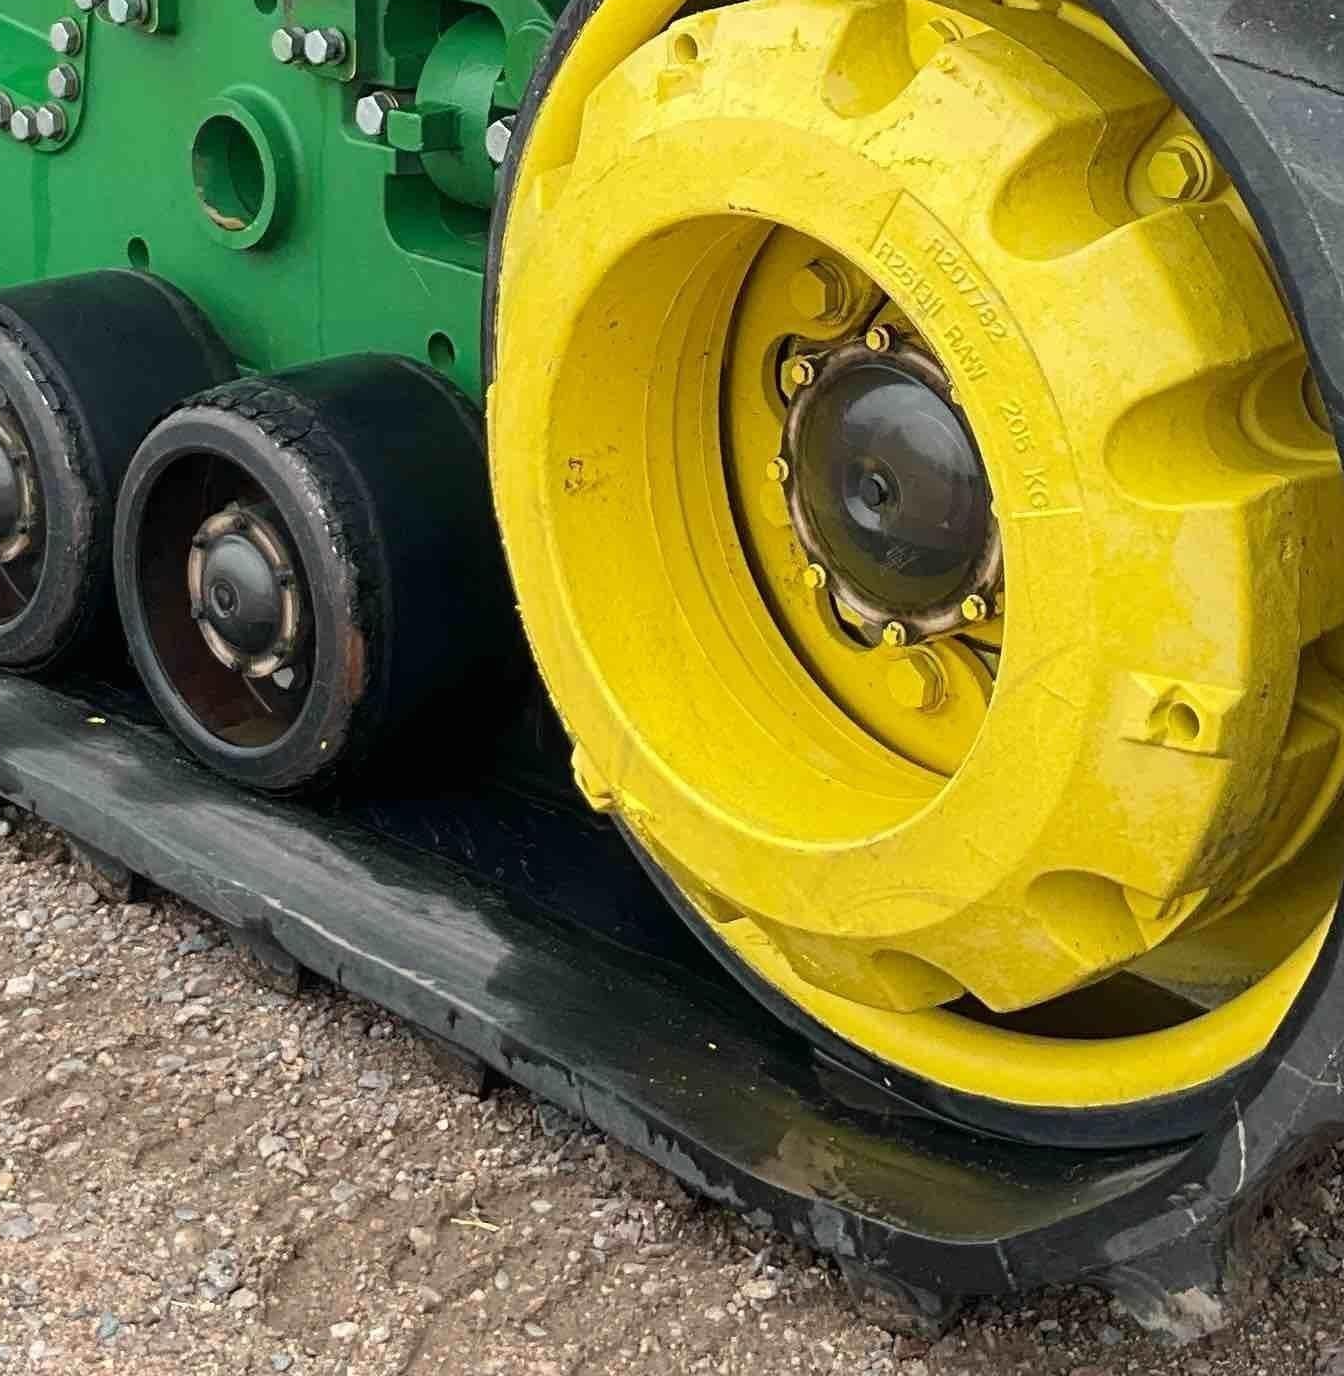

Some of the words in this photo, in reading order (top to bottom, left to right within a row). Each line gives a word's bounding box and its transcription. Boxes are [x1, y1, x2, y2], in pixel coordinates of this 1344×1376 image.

[943, 324, 989, 383] RAW
[997, 399, 1037, 456] 205
[1023, 466, 1051, 511] KG
